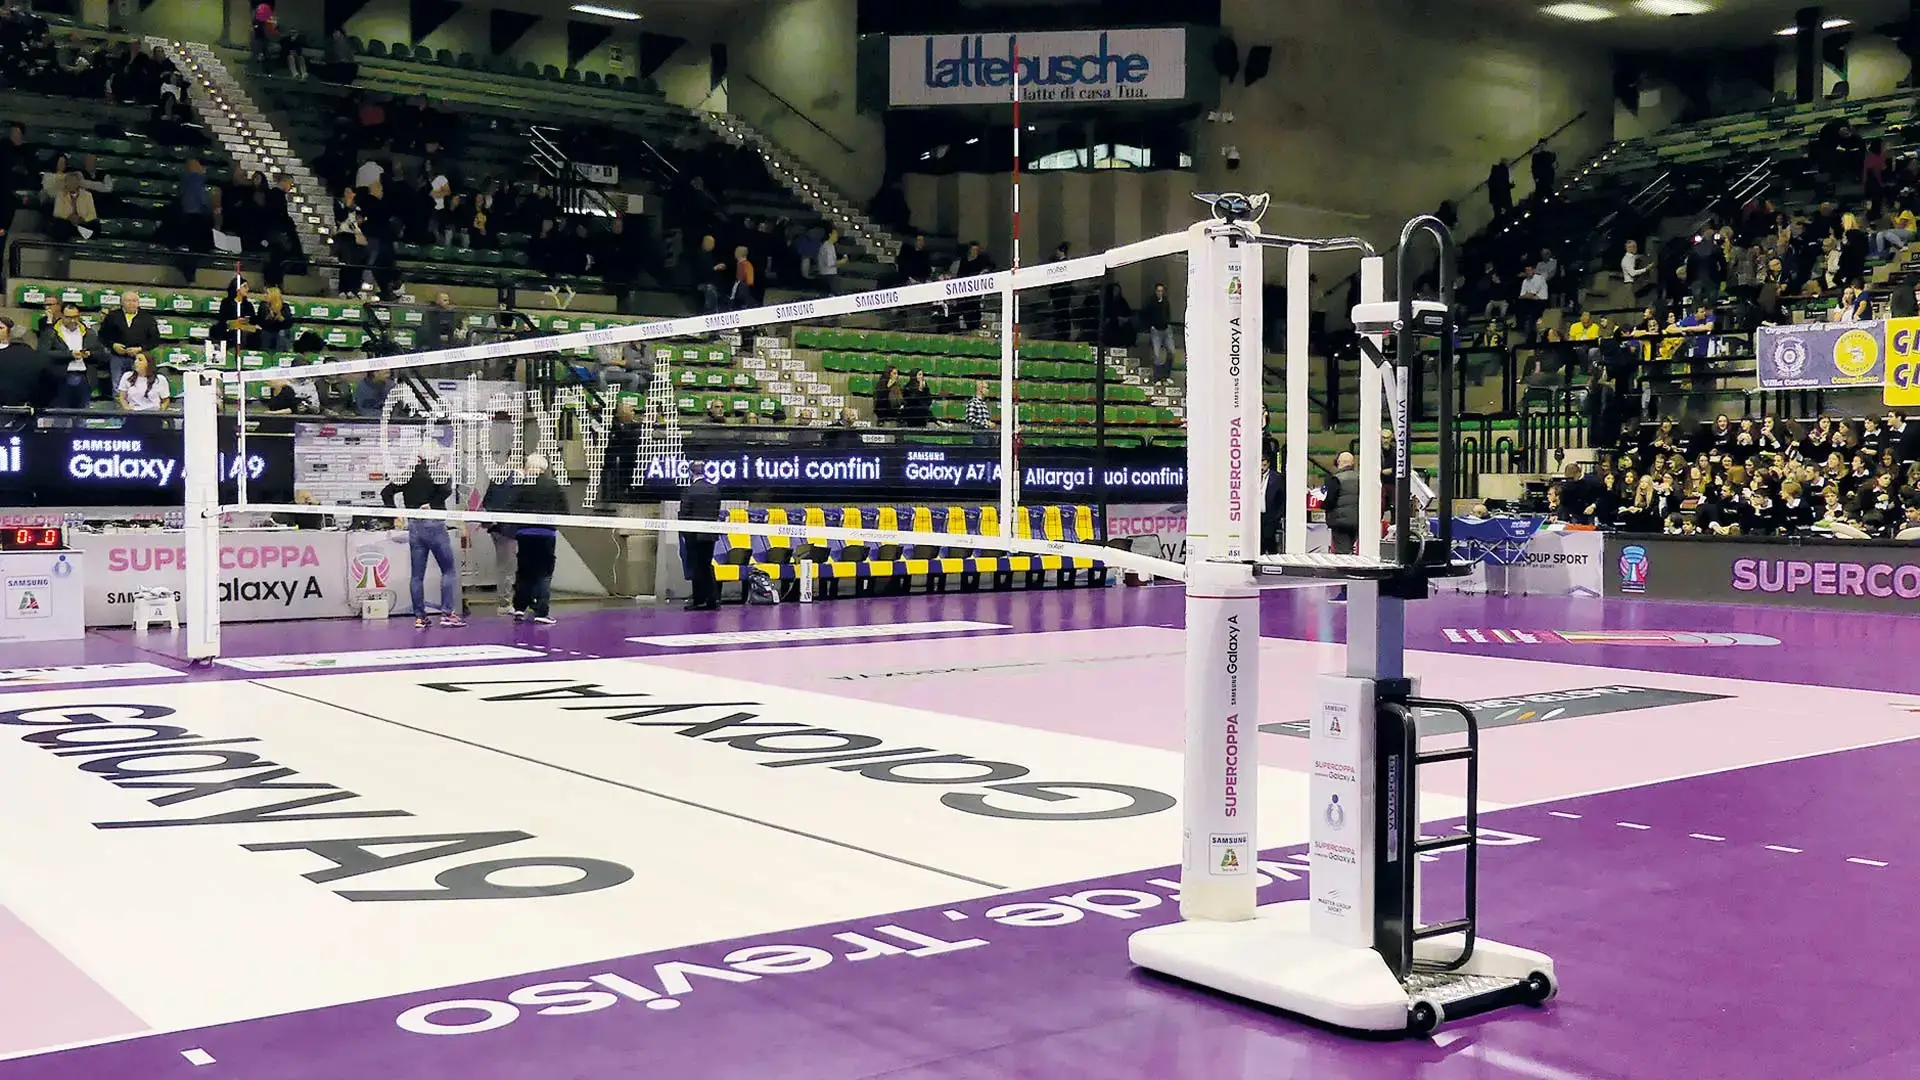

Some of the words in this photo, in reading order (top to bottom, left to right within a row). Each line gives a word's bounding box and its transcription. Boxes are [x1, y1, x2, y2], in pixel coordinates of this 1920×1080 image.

[925, 32, 1149, 89] lattebusche
[1024, 87, 1056, 100] latte
[1061, 87, 1075, 99] di
[1079, 89, 1111, 99] casa
[945, 276, 994, 296] SAMSUNG
[855, 291, 899, 308] SAMSUNG
[705, 312, 740, 328] SAMSUNG
[776, 303, 815, 318] SAMSUNG
[641, 322, 673, 336] SAMSUNG
[1230, 317, 1240, 326] A
[1229, 329, 1242, 377] Galaxy
[72, 439, 142, 452] SAMSUNG
[1397, 399, 1406, 478] VIVISPORT
[907, 451, 945, 461] SAMSUNG
[69, 453, 177, 487] Galaxy
[742, 454, 749, 479] i
[755, 455, 800, 480] tuoi
[805, 456, 881, 480] confini
[905, 463, 964, 486] Galaxy
[965, 463, 986, 481] A7
[1230, 416, 1242, 522] SUPERCOPPA
[1025, 467, 1085, 491] Allarga
[1087, 467, 1094, 485] i
[1103, 467, 1128, 486] uoi
[1132, 466, 1183, 486] confini
[777, 526, 808, 537] SAMSUNG
[108, 544, 320, 572] SUPECOPPA
[1553, 553, 1588, 565] SPORT
[8, 579, 48, 587] SAMSUNG
[1732, 557, 1920, 599] SUPERCO
[218, 577, 299, 606] alaxy
[303, 576, 324, 599] A
[1228, 614, 1238, 624] A
[1227, 626, 1241, 674] Galaxy
[560, 701, 1177, 821] Galaxy
[1225, 713, 1239, 817] SUPERCOPPA
[1314, 760, 1356, 773] SUPERCOPPA
[1328, 771, 1350, 783] Galaxy
[0, 703, 418, 830] Galaxy
[239, 830, 635, 903] A9
[1314, 841, 1356, 855] SUPERCOPPA
[1328, 852, 1350, 864] Galaxy
[396, 922, 990, 1037] Treviso
